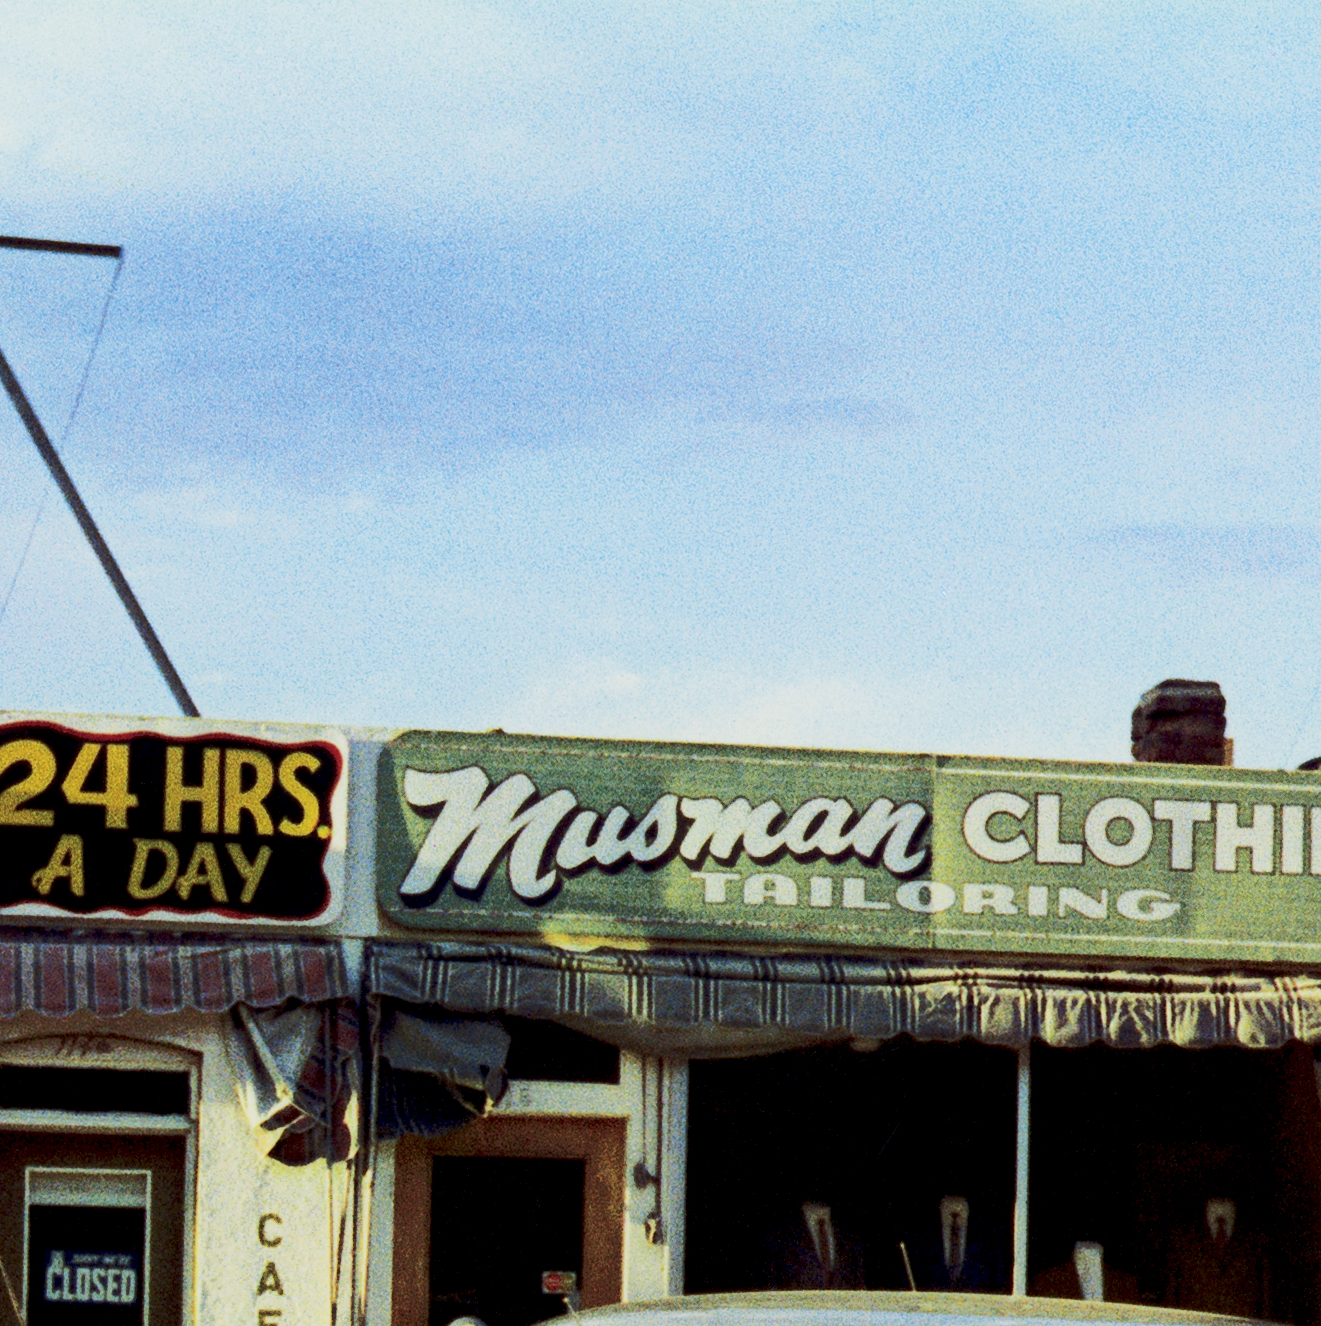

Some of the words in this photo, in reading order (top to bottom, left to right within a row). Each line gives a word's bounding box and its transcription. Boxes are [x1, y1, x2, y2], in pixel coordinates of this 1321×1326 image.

[165, 747, 332, 841] HRS.
[398, 765, 932, 902] Musman
[32, 835, 84, 897] A
[129, 837, 272, 903] DAY
[692, 872, 1182, 922] TAILORING
[45, 1266, 136, 1303] CLOSED
